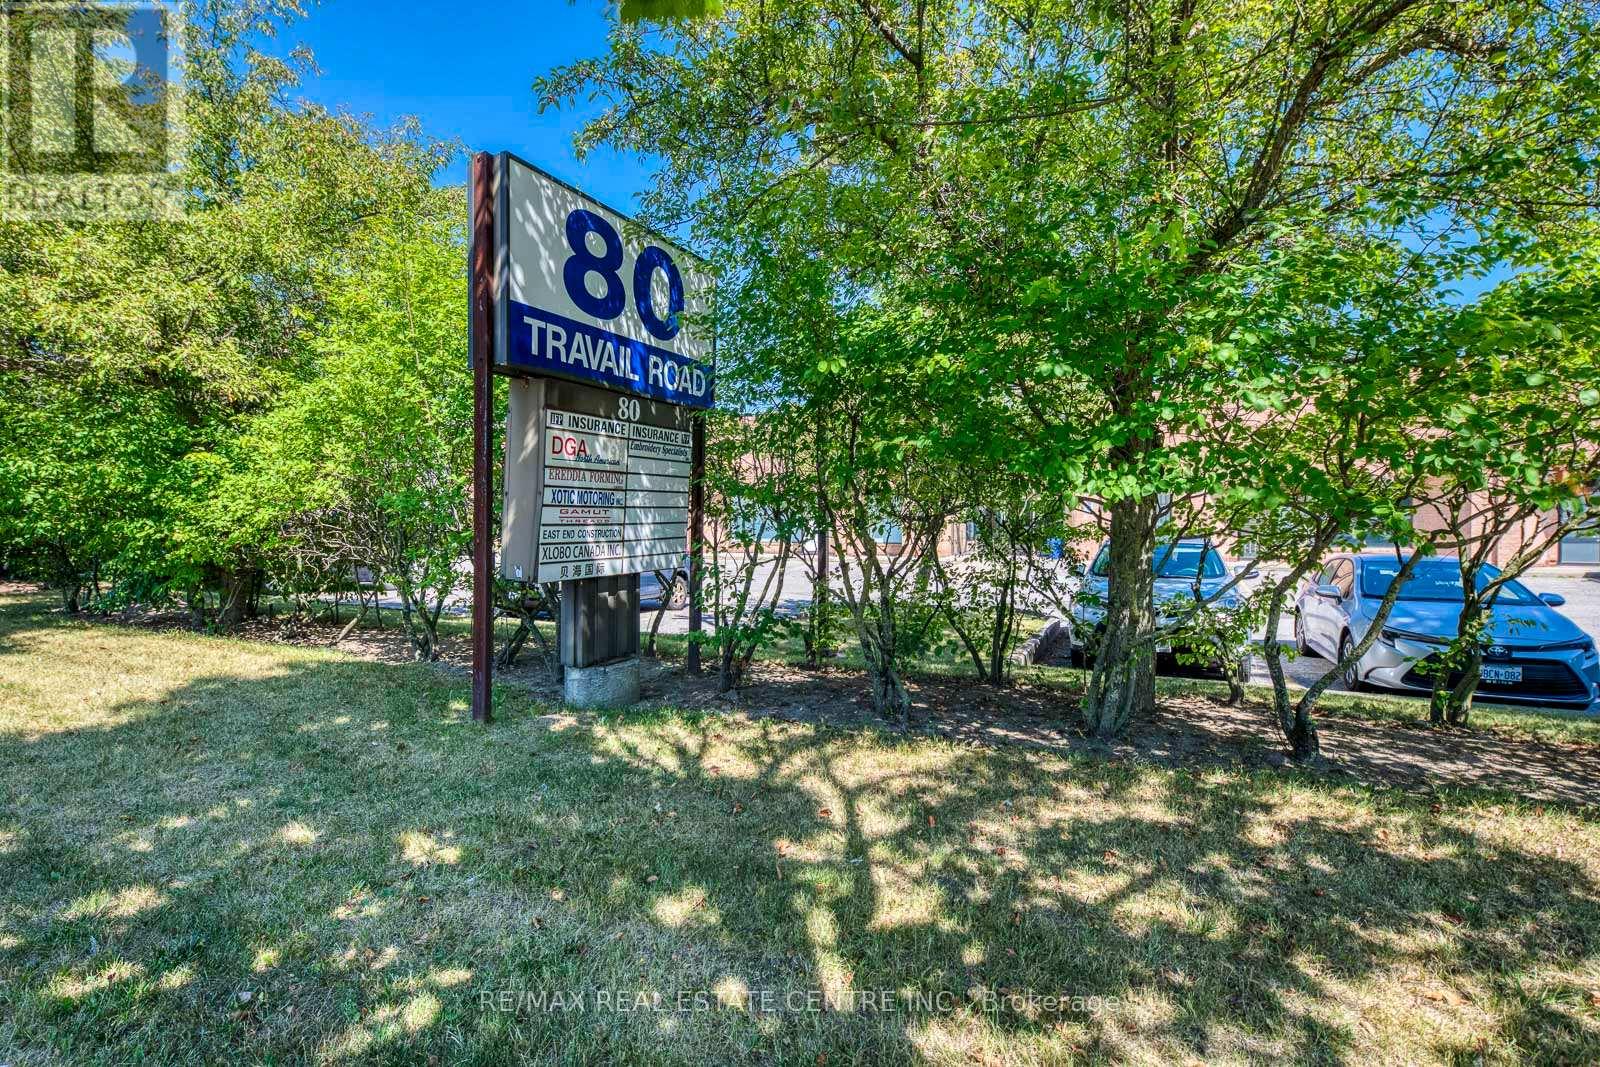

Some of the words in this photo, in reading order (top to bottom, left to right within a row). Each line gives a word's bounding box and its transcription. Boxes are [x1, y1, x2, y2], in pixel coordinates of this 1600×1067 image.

[563, 209, 684, 341] 80
[523, 316, 640, 382] TRAVAIL
[649, 354, 706, 398] ROAD
[617, 396, 640, 421] 80
[568, 415, 626, 435] INSURANCE
[632, 425, 679, 443] INSURANCE
[552, 436, 587, 457] DGA
[549, 468, 586, 482] EREDDIA
[590, 471, 623, 484] FORMING
[551, 489, 575, 504] XOTIC
[577, 490, 615, 506] MOTORING
[543, 529, 560, 540] EAST
[562, 529, 575, 539] END
[577, 529, 622, 539] CONSTRUCTION
[542, 546, 571, 561] XLOBO
[573, 545, 606, 558] CANADA
